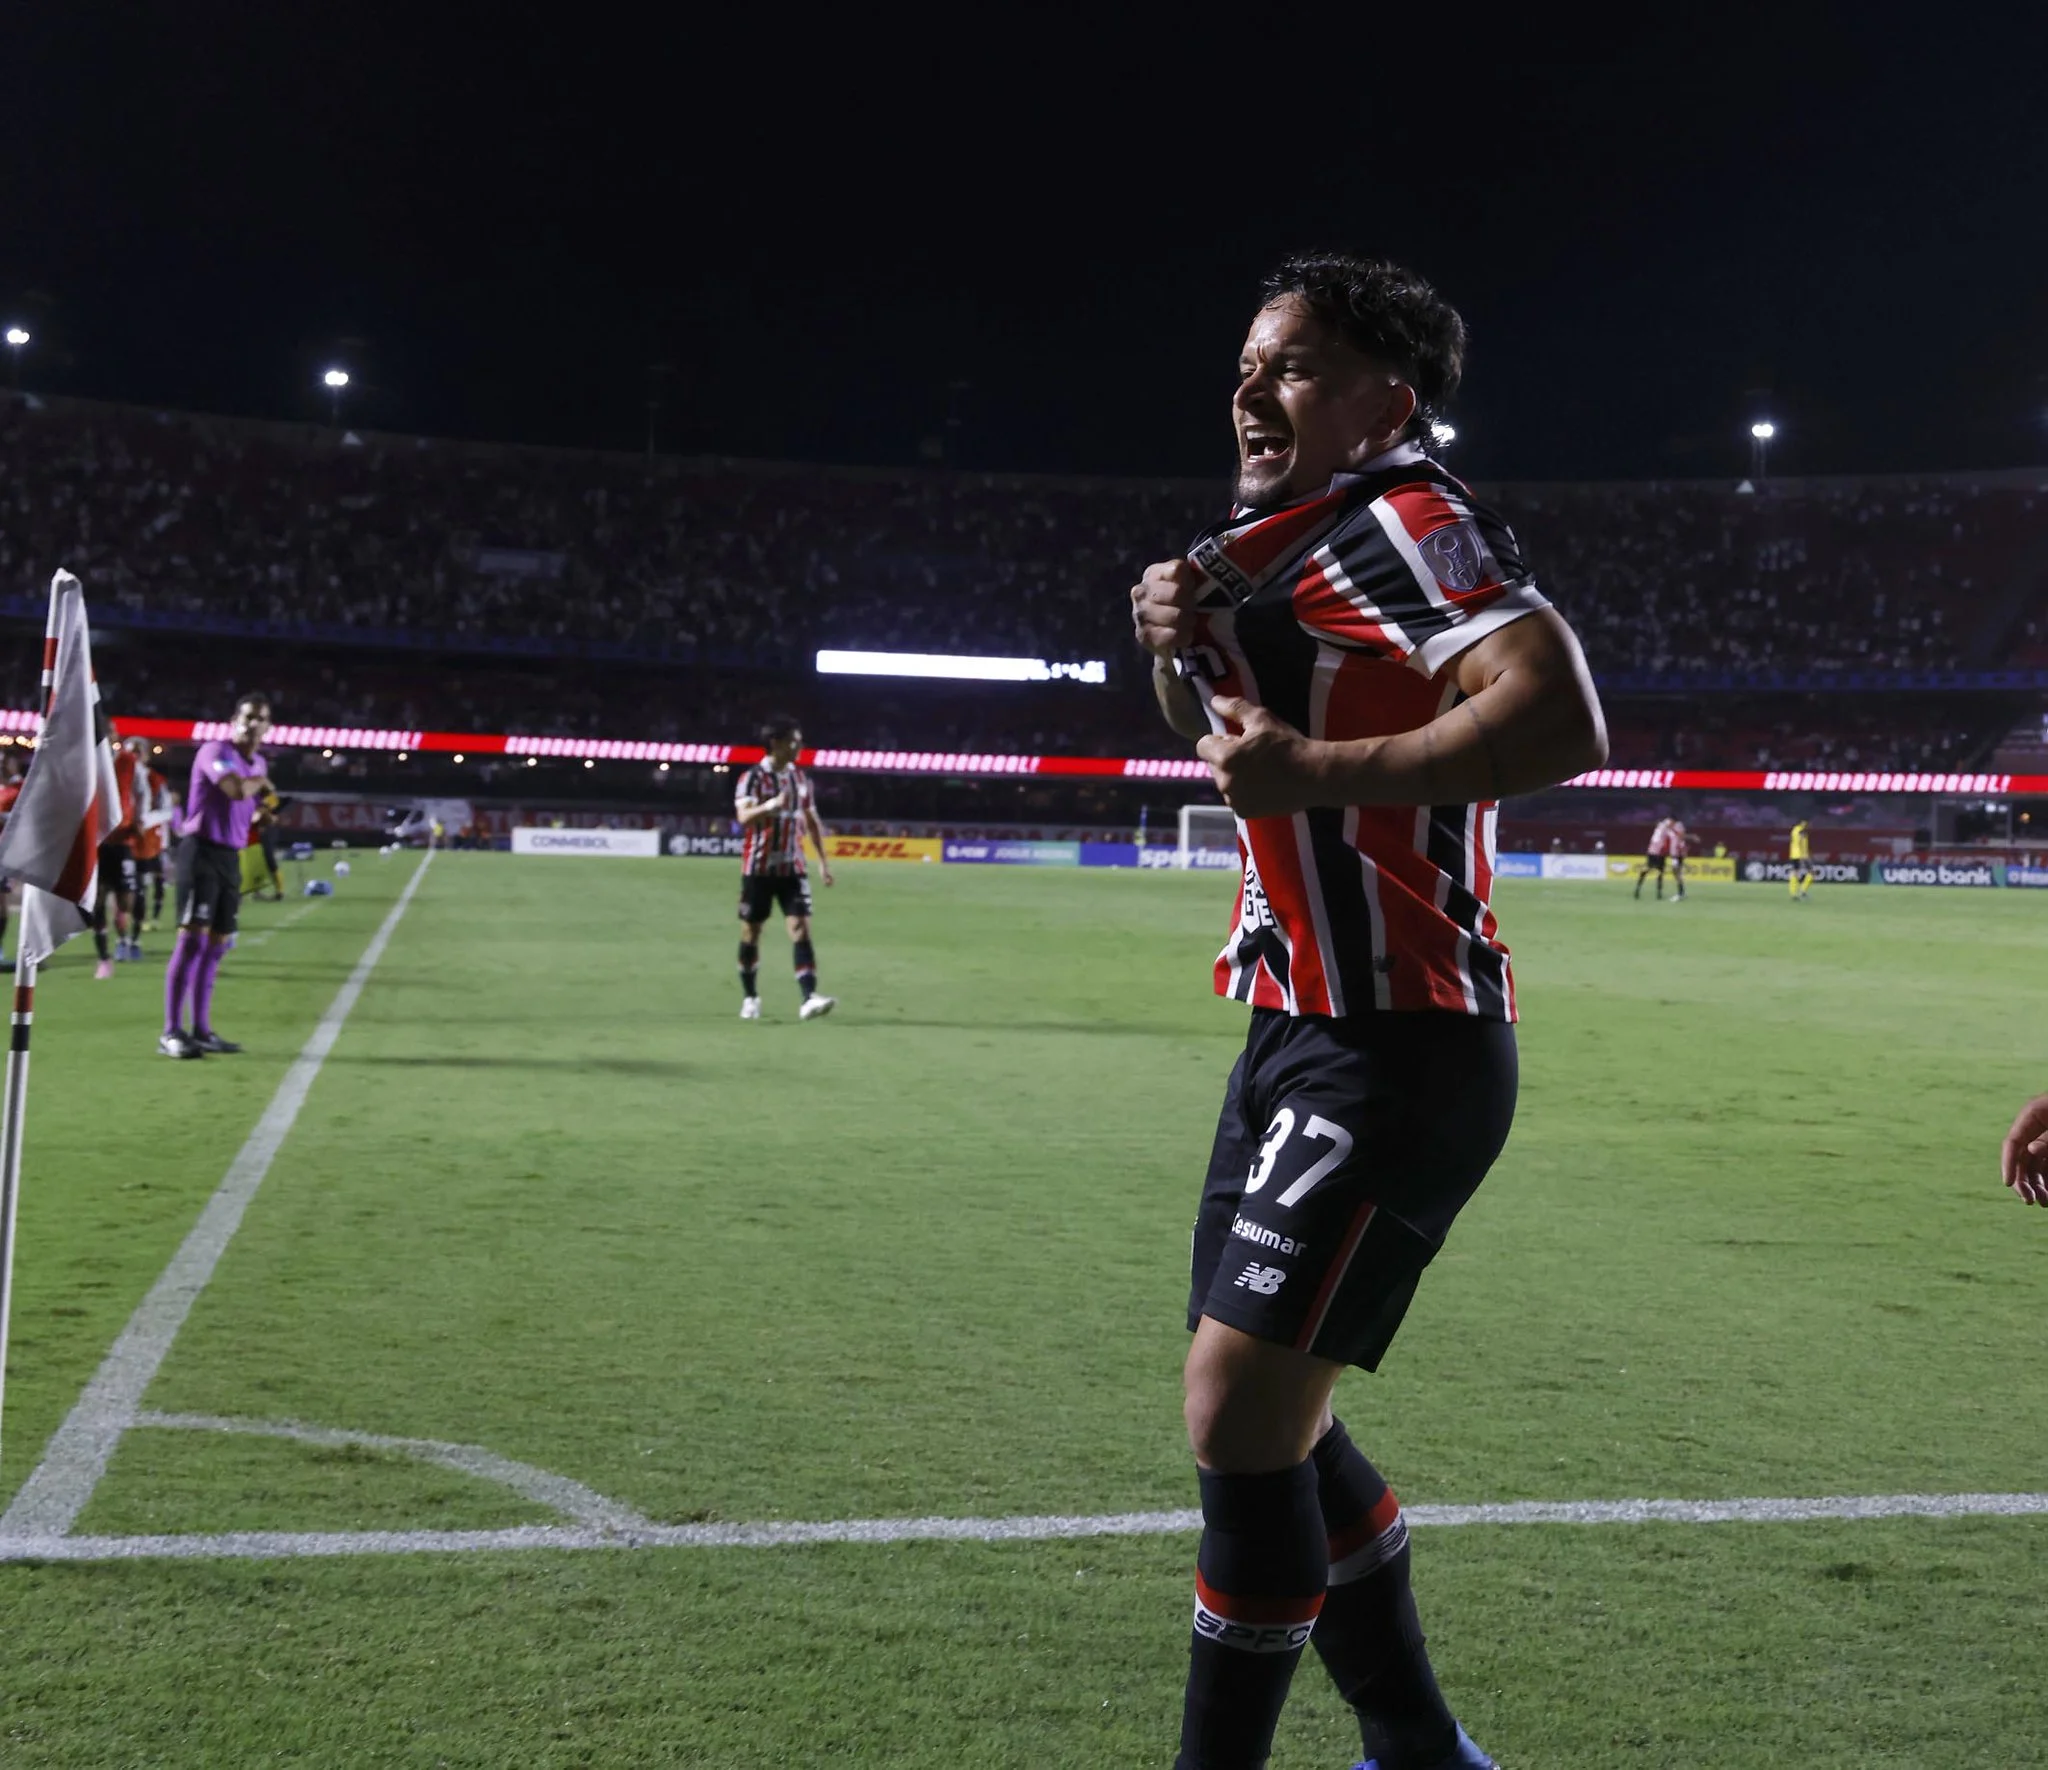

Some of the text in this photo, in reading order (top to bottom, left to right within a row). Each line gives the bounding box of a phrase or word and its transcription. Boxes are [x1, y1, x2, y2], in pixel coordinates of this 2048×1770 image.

[1194, 543, 1254, 602] SPFC
[835, 842, 908, 858] DHL
[1883, 867, 1992, 884] ueno bank
[1244, 1107, 1354, 1208] 37
[1195, 1609, 1311, 1649] SPFC
